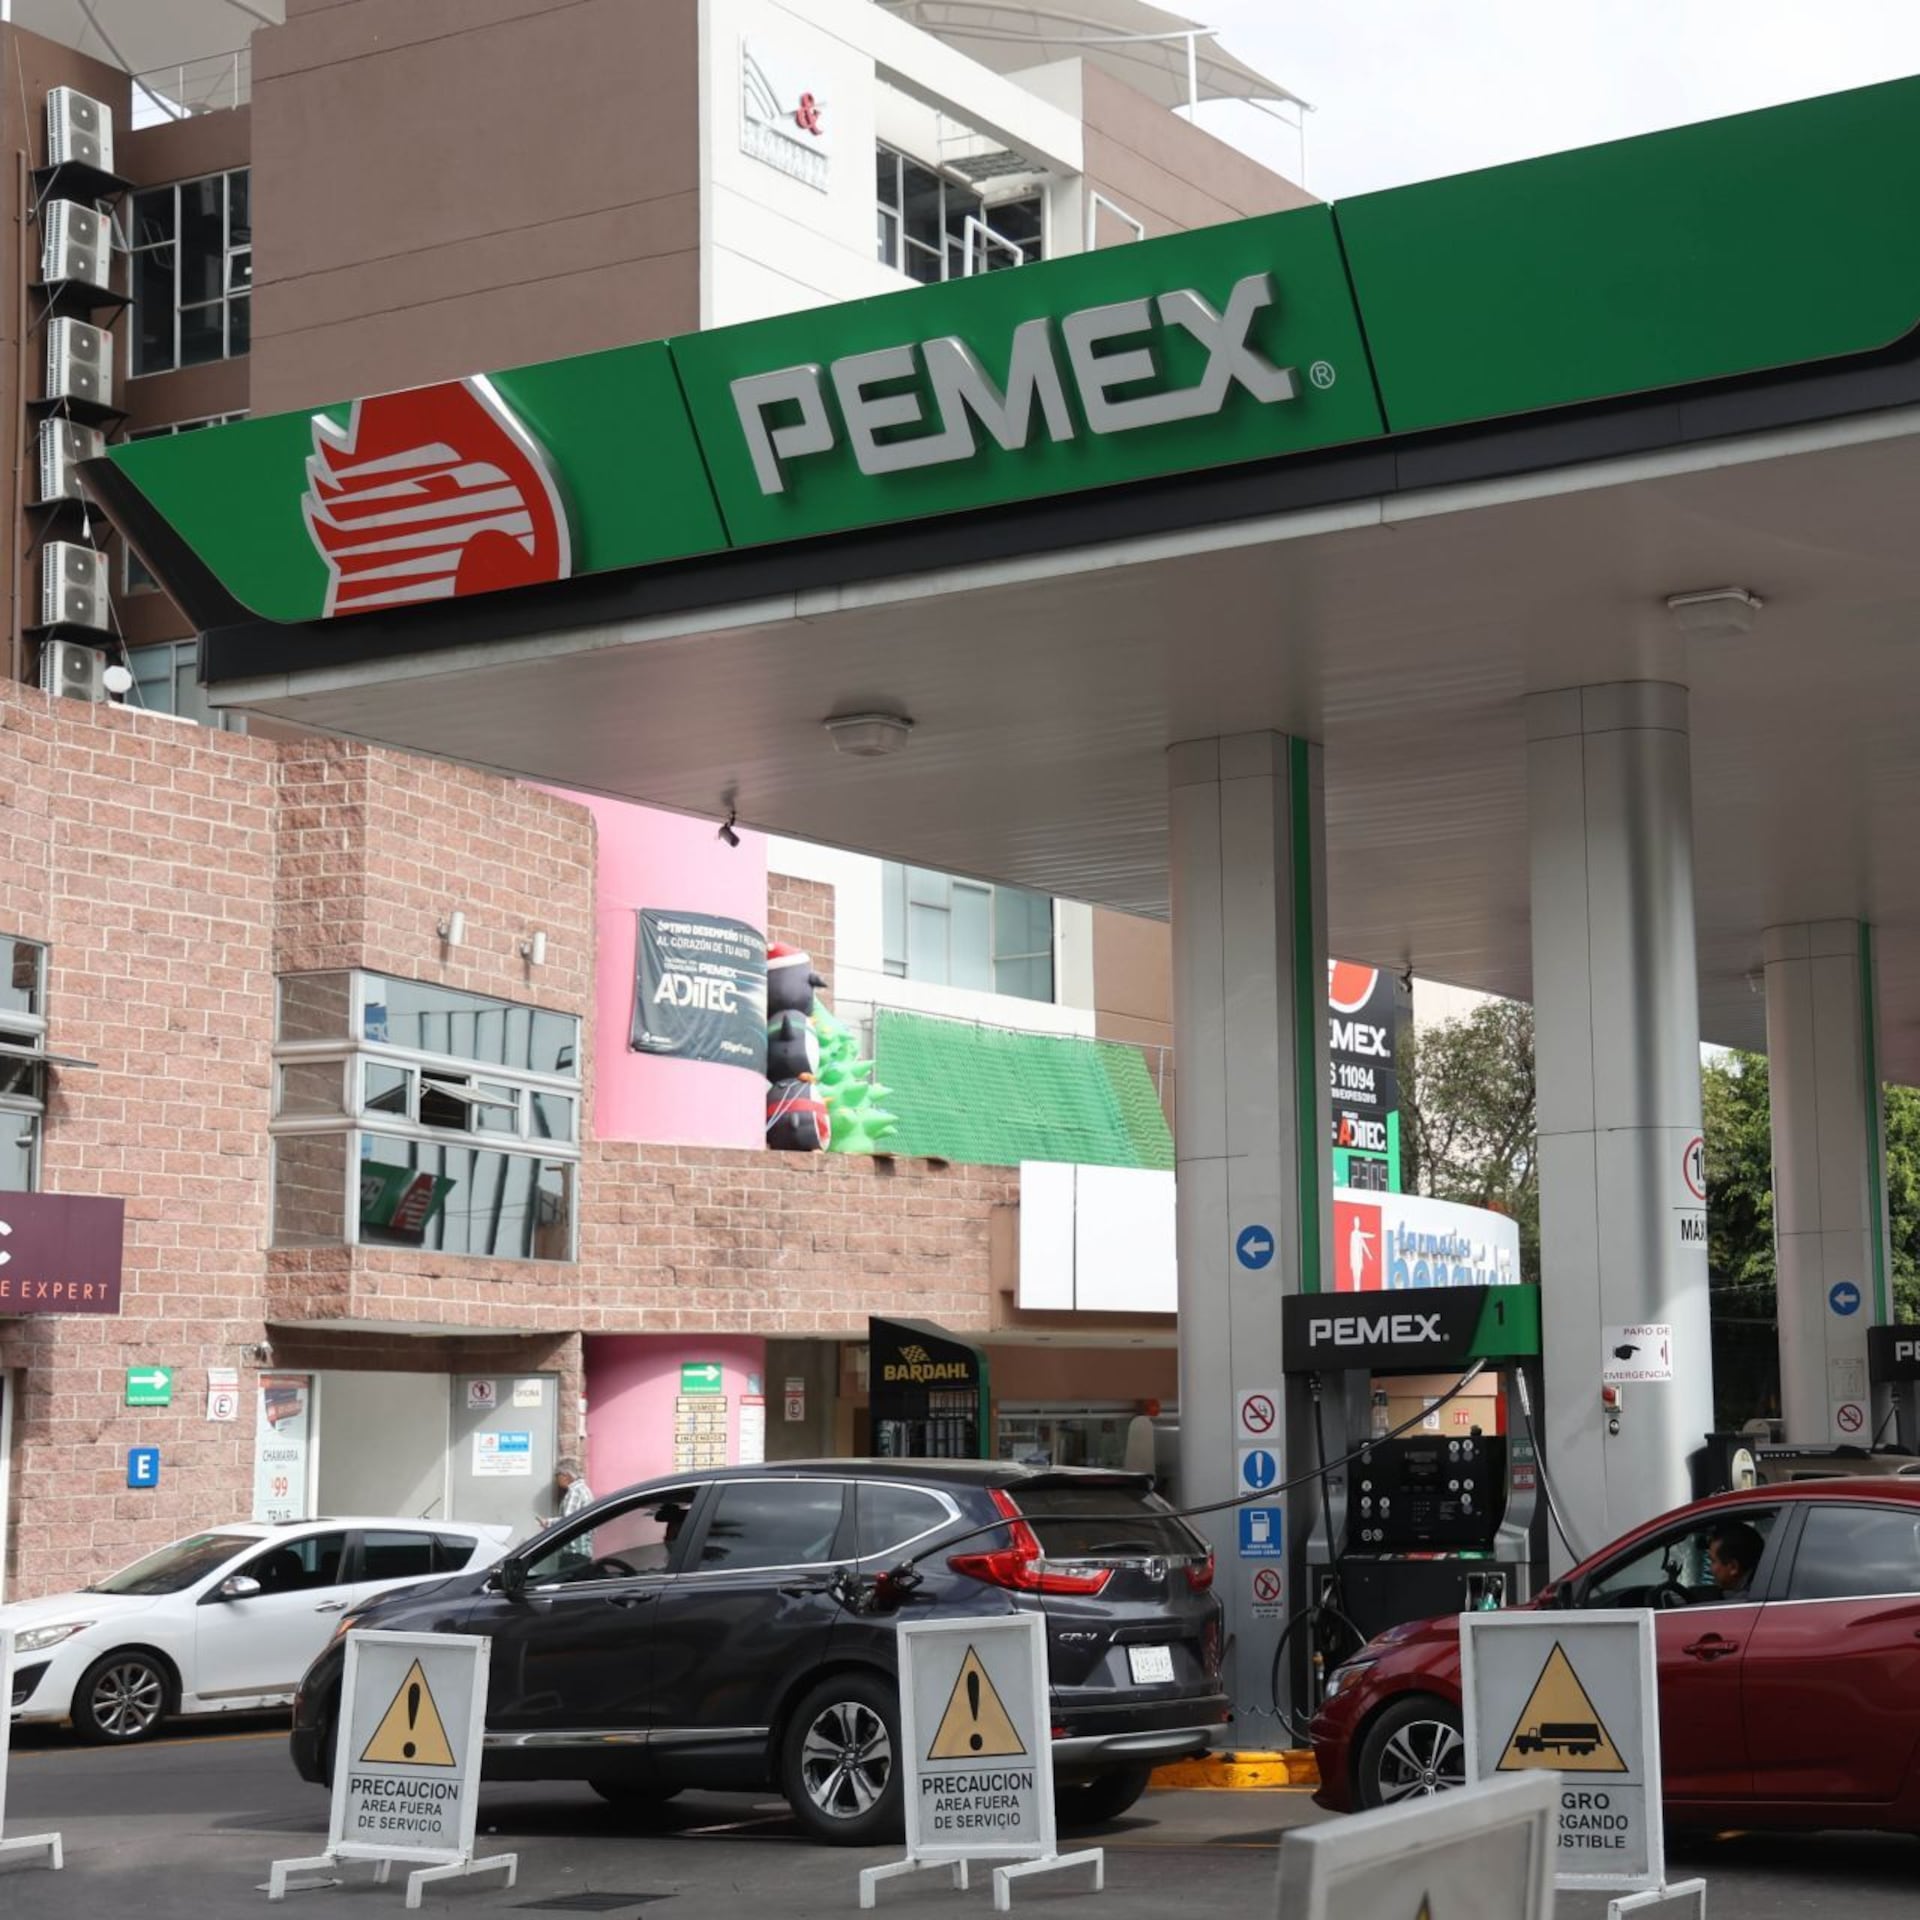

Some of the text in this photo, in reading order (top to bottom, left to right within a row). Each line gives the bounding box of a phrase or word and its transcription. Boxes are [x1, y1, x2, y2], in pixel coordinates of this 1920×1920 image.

[730, 272, 1299, 496] PEMEX
[1329, 1017, 1387, 1058] MEX
[1338, 1063, 1376, 1092] 11094
[21, 1281, 108, 1300] EXPERT
[1494, 1301, 1505, 1326] 1
[1309, 1313, 1442, 1347] PEMEX
[1623, 1327, 1671, 1336] PARO DE
[883, 1362, 969, 1383] BARDAHL
[1603, 1370, 1672, 1380] EMERGENCIA
[262, 1449, 299, 1463] CHAMARRA
[137, 1455, 151, 1479] E
[350, 1778, 459, 1801] PRECAUCION
[921, 1772, 1033, 1796] PRECAUCION
[360, 1799, 443, 1817] AREA FUERA
[935, 1795, 1020, 1812] AREA FUERA
[1561, 1792, 1610, 1810] GRO
[357, 1814, 442, 1834] DE SERVICIO
[934, 1812, 1021, 1830] DE SERVICIO
